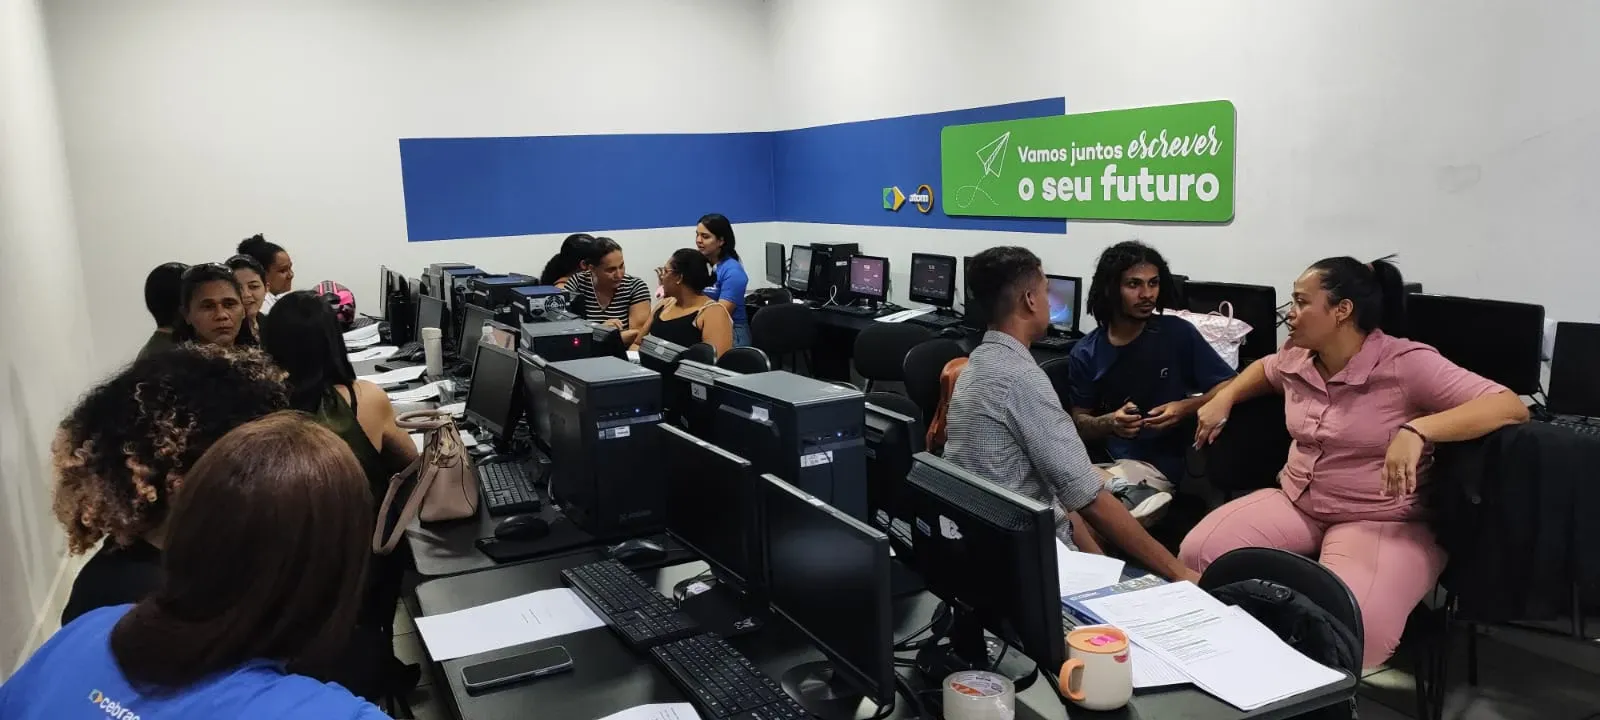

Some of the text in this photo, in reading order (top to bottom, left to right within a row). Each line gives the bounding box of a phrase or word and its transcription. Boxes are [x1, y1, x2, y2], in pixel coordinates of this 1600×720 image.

[1017, 125, 1223, 167] Vamos juntos escrever
[1018, 163, 1220, 202] o seu futuro
